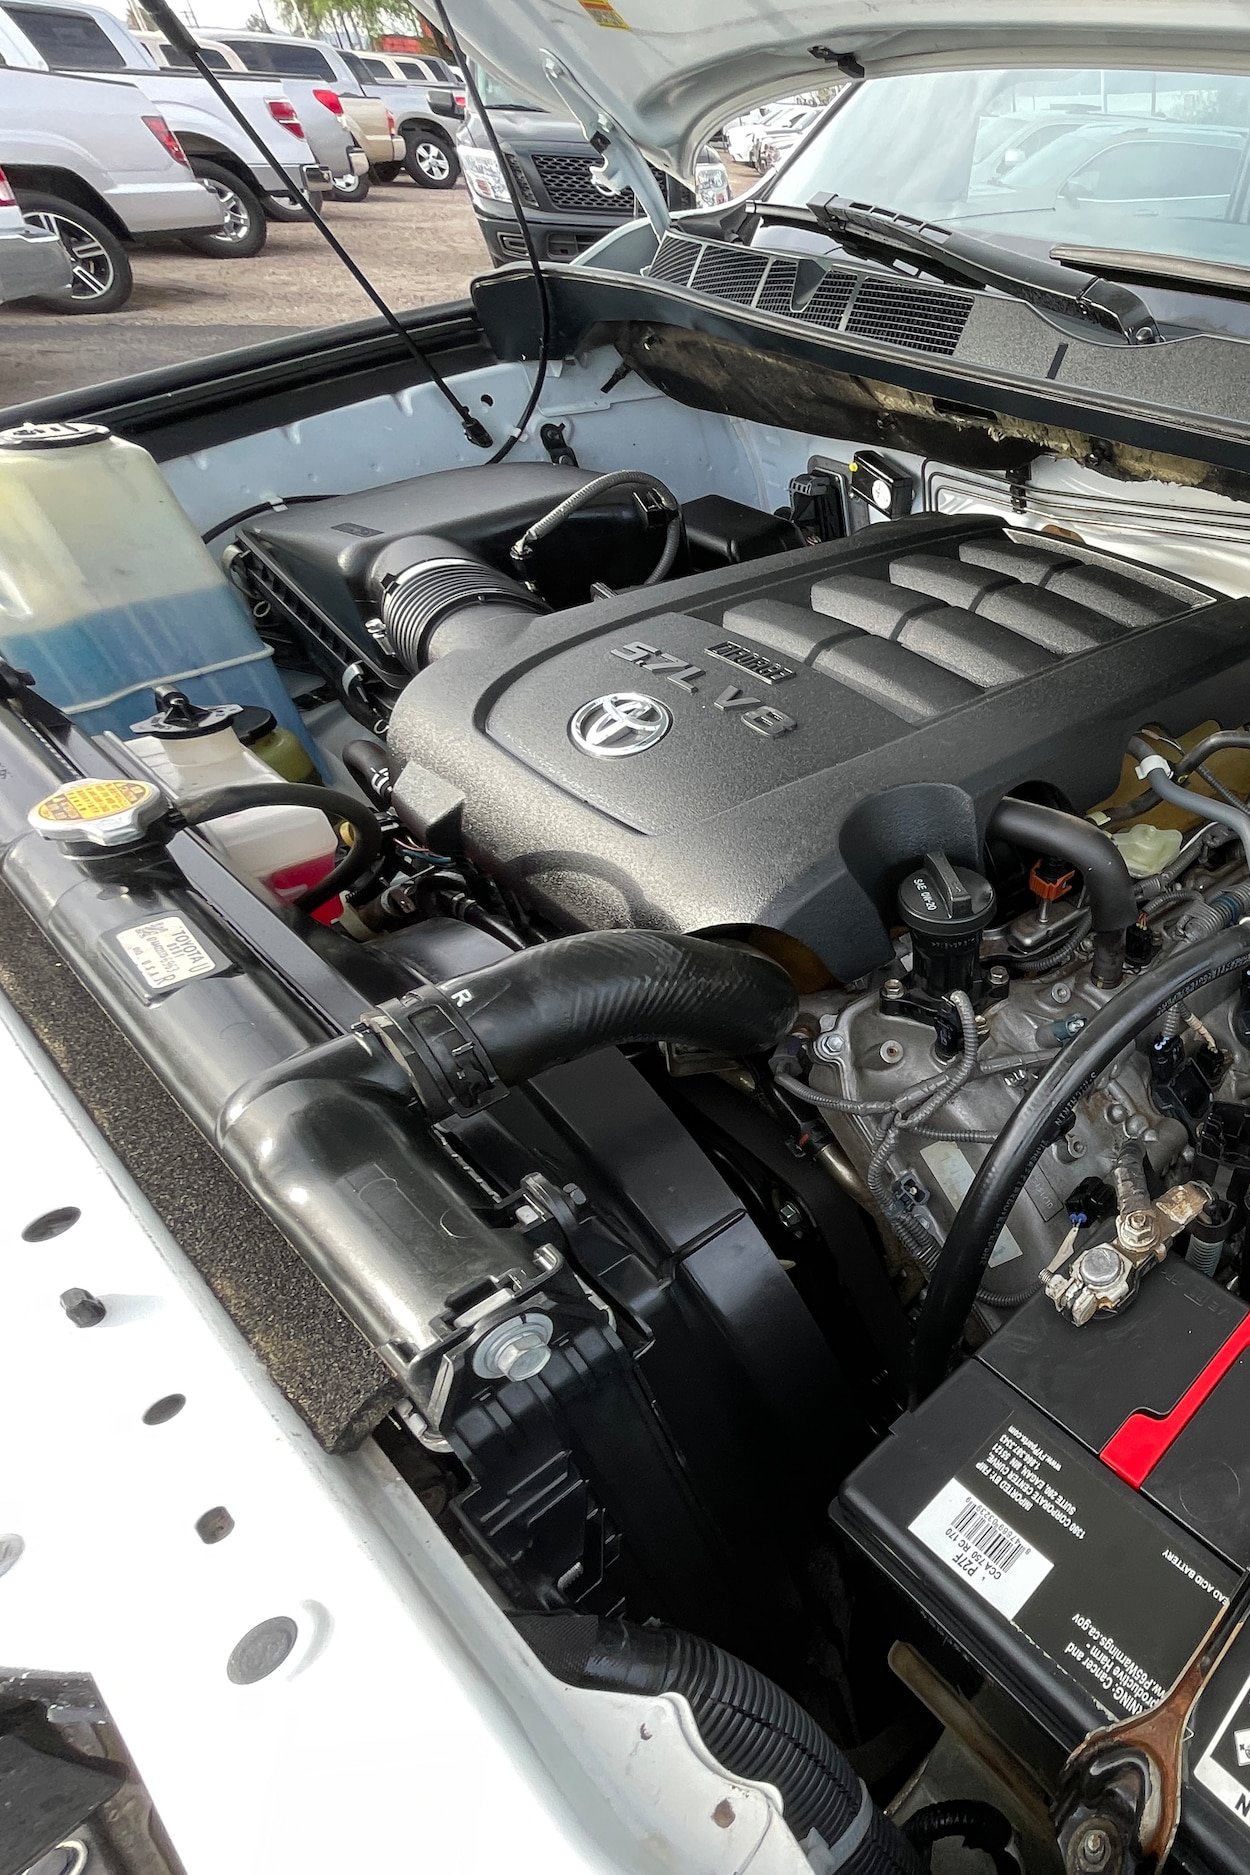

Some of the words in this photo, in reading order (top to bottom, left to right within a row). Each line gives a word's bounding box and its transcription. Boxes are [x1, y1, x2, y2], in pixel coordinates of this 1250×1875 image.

[610, 641, 706, 695] 5.7L
[714, 685, 798, 737] V8
[913, 878, 927, 890] SAE
[920, 891, 937, 910] 0W-20
[171, 929, 205, 964] TOYOTA
[450, 988, 473, 1008] R
[991, 1442, 1011, 1461] 55121
[1007, 1425, 1061, 1471] www.FVPparts.com
[975, 1461, 992, 1476] FMP
[986, 1451, 1010, 1475] CURVE,
[1008, 1456, 1022, 1470] MN
[988, 1470, 1002, 1485] BY:
[1006, 1470, 1034, 1495] CENTER
[1020, 1464, 1045, 1489] EAGAN,
[998, 1480, 1033, 1511] IMPORTED
[1054, 1494, 1076, 1515] SUITE
[1030, 1490, 1071, 1527] CORPORATE
[944, 1527, 959, 1541] 170
[1068, 1522, 1085, 1539] 1380
[957, 1538, 971, 1552] RC
[951, 1552, 978, 1576] P27F
[970, 1550, 985, 1566] 750
[1161, 1549, 1196, 1579] BATTERY
[984, 1561, 1001, 1580] CCA
[1194, 1574, 1214, 1592] ACID
[1212, 1589, 1229, 1606] EAD
[1063, 1641, 1084, 1661] and
[1089, 1645, 1114, 1672] Harm
[1081, 1657, 1113, 1689] Cancer
[1112, 1665, 1159, 1710] productive
